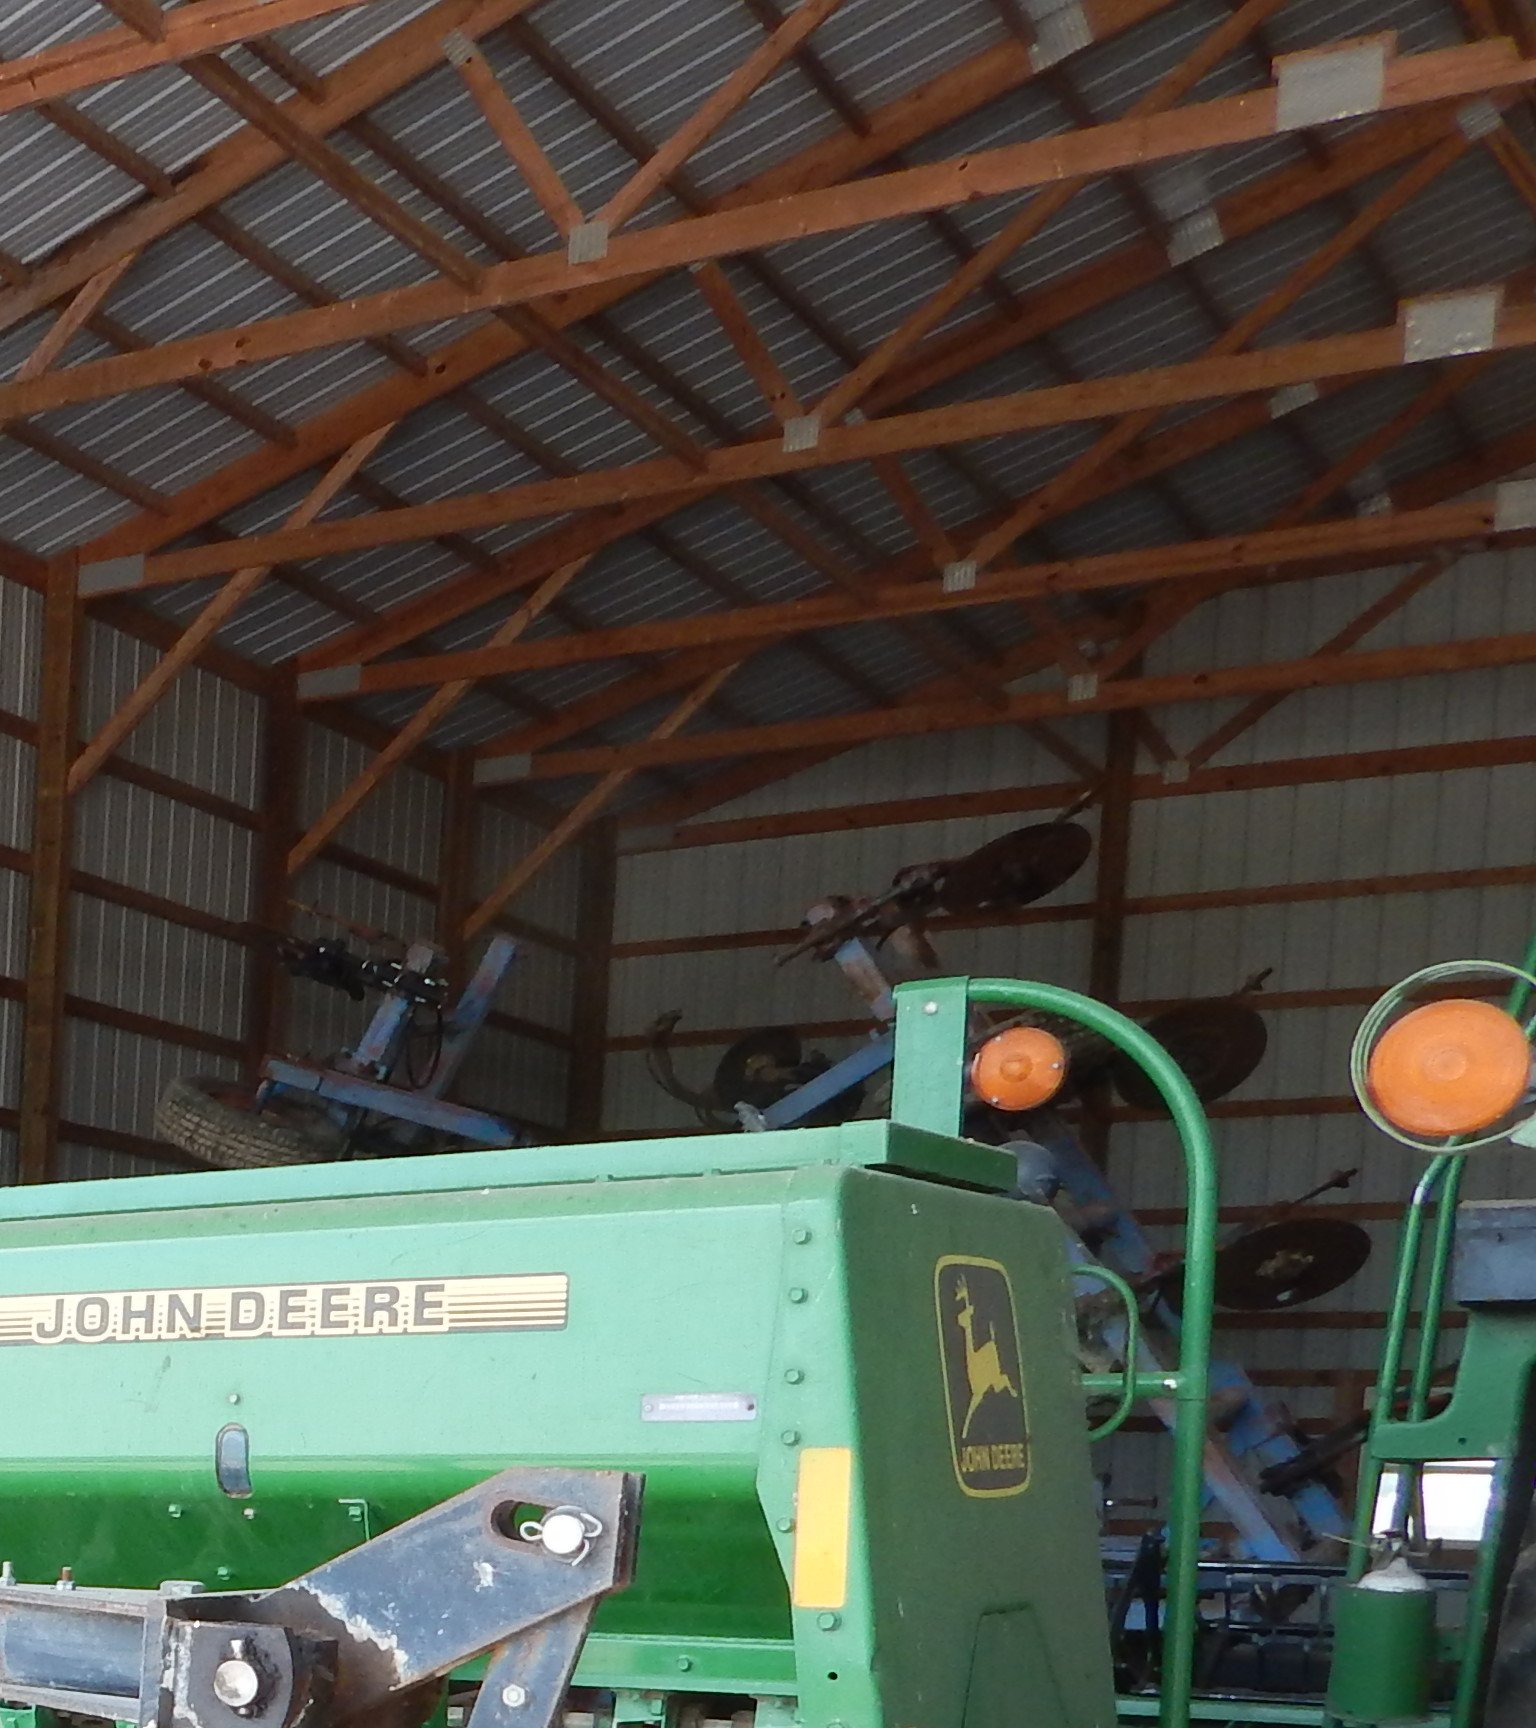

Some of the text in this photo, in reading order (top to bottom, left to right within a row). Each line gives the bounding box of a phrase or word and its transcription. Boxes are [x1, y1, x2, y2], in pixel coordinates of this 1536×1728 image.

[35, 1282, 446, 1340] JOHN DEERE
[960, 1443, 1026, 1473] JOHN DEERE
